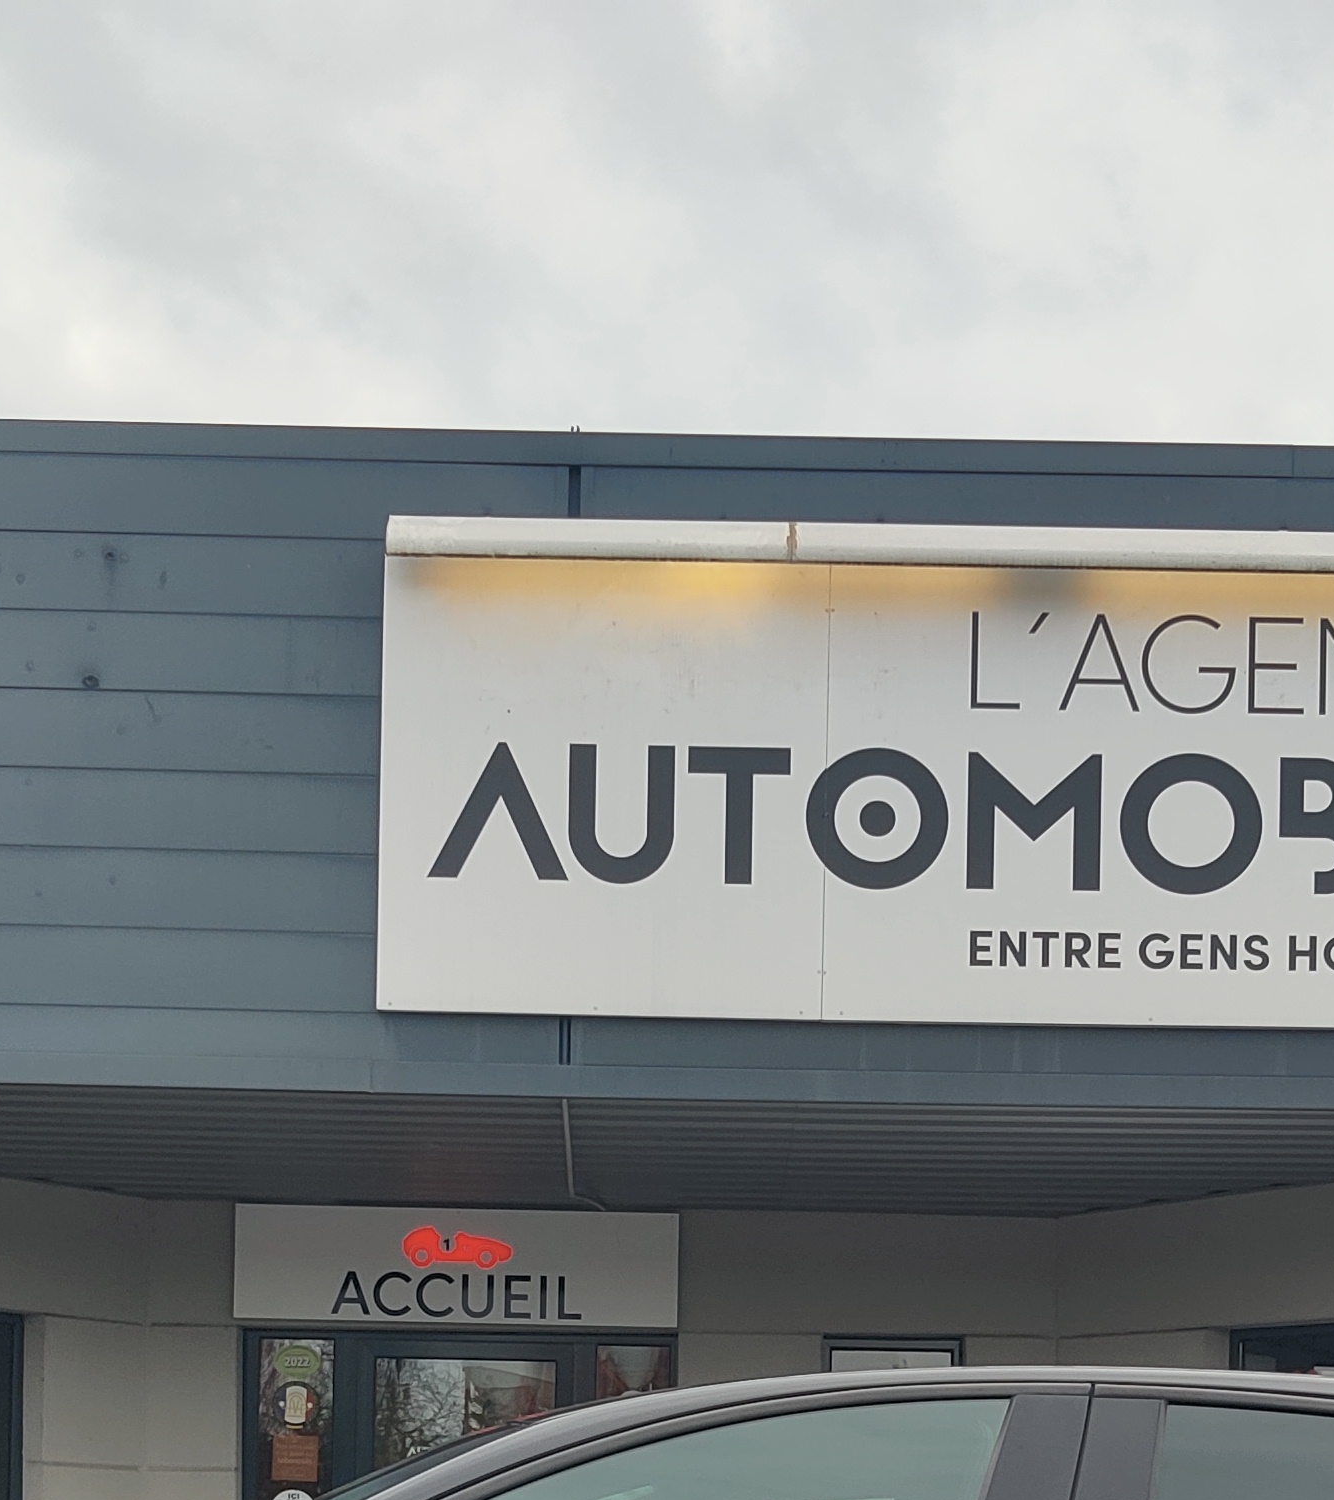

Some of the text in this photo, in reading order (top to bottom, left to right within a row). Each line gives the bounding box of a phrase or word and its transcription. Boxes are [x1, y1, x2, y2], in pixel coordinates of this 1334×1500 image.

[969, 930, 1122, 970] ENTRE
[1139, 931, 1270, 972] GENS
[442, 1237, 450, 1251] 1
[331, 1271, 582, 1320] ACCUEIL
[285, 1357, 310, 1367] 2022
